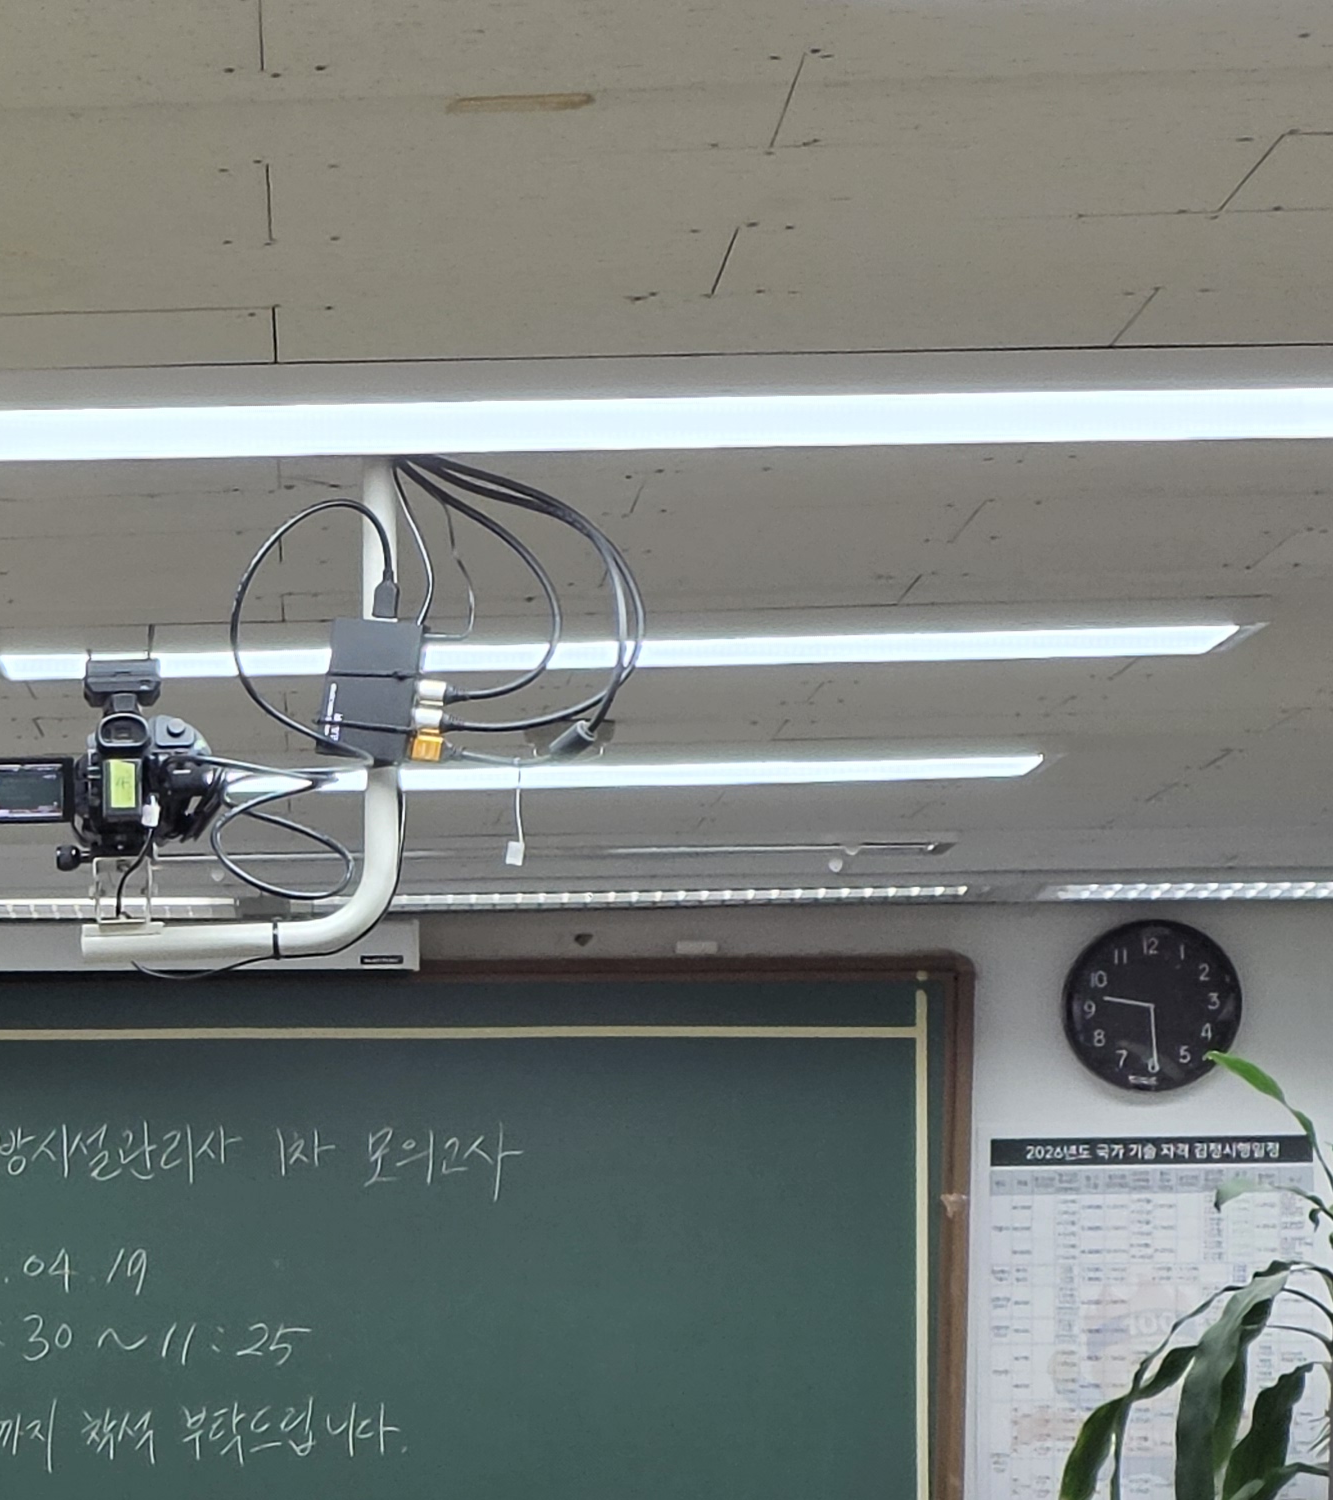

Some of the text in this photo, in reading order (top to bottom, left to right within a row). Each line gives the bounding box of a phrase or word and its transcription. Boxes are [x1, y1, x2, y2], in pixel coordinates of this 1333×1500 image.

[1143, 938, 1159, 954] 12
[1179, 944, 1185, 960] 1
[1114, 948, 1127, 964] 11
[1090, 970, 1108, 988] 10
[1199, 963, 1210, 981] 2
[1083, 1001, 1096, 1019] 9
[1207, 992, 1220, 1010] 3
[1093, 1029, 1105, 1047] 8
[1201, 1022, 1212, 1041] 4
[1115, 1050, 1128, 1068] 7
[1179, 1045, 1191, 1063] 5
[1026, 1144, 1092, 1161] 2026년도
[1096, 1143, 1124, 1160] 국가
[1129, 1142, 1157, 1160] 기술
[1161, 1143, 1189, 1160] 자격
[363, 1121, 524, 1202] 모의고사
[81, 1406, 155, 1465] 착석
